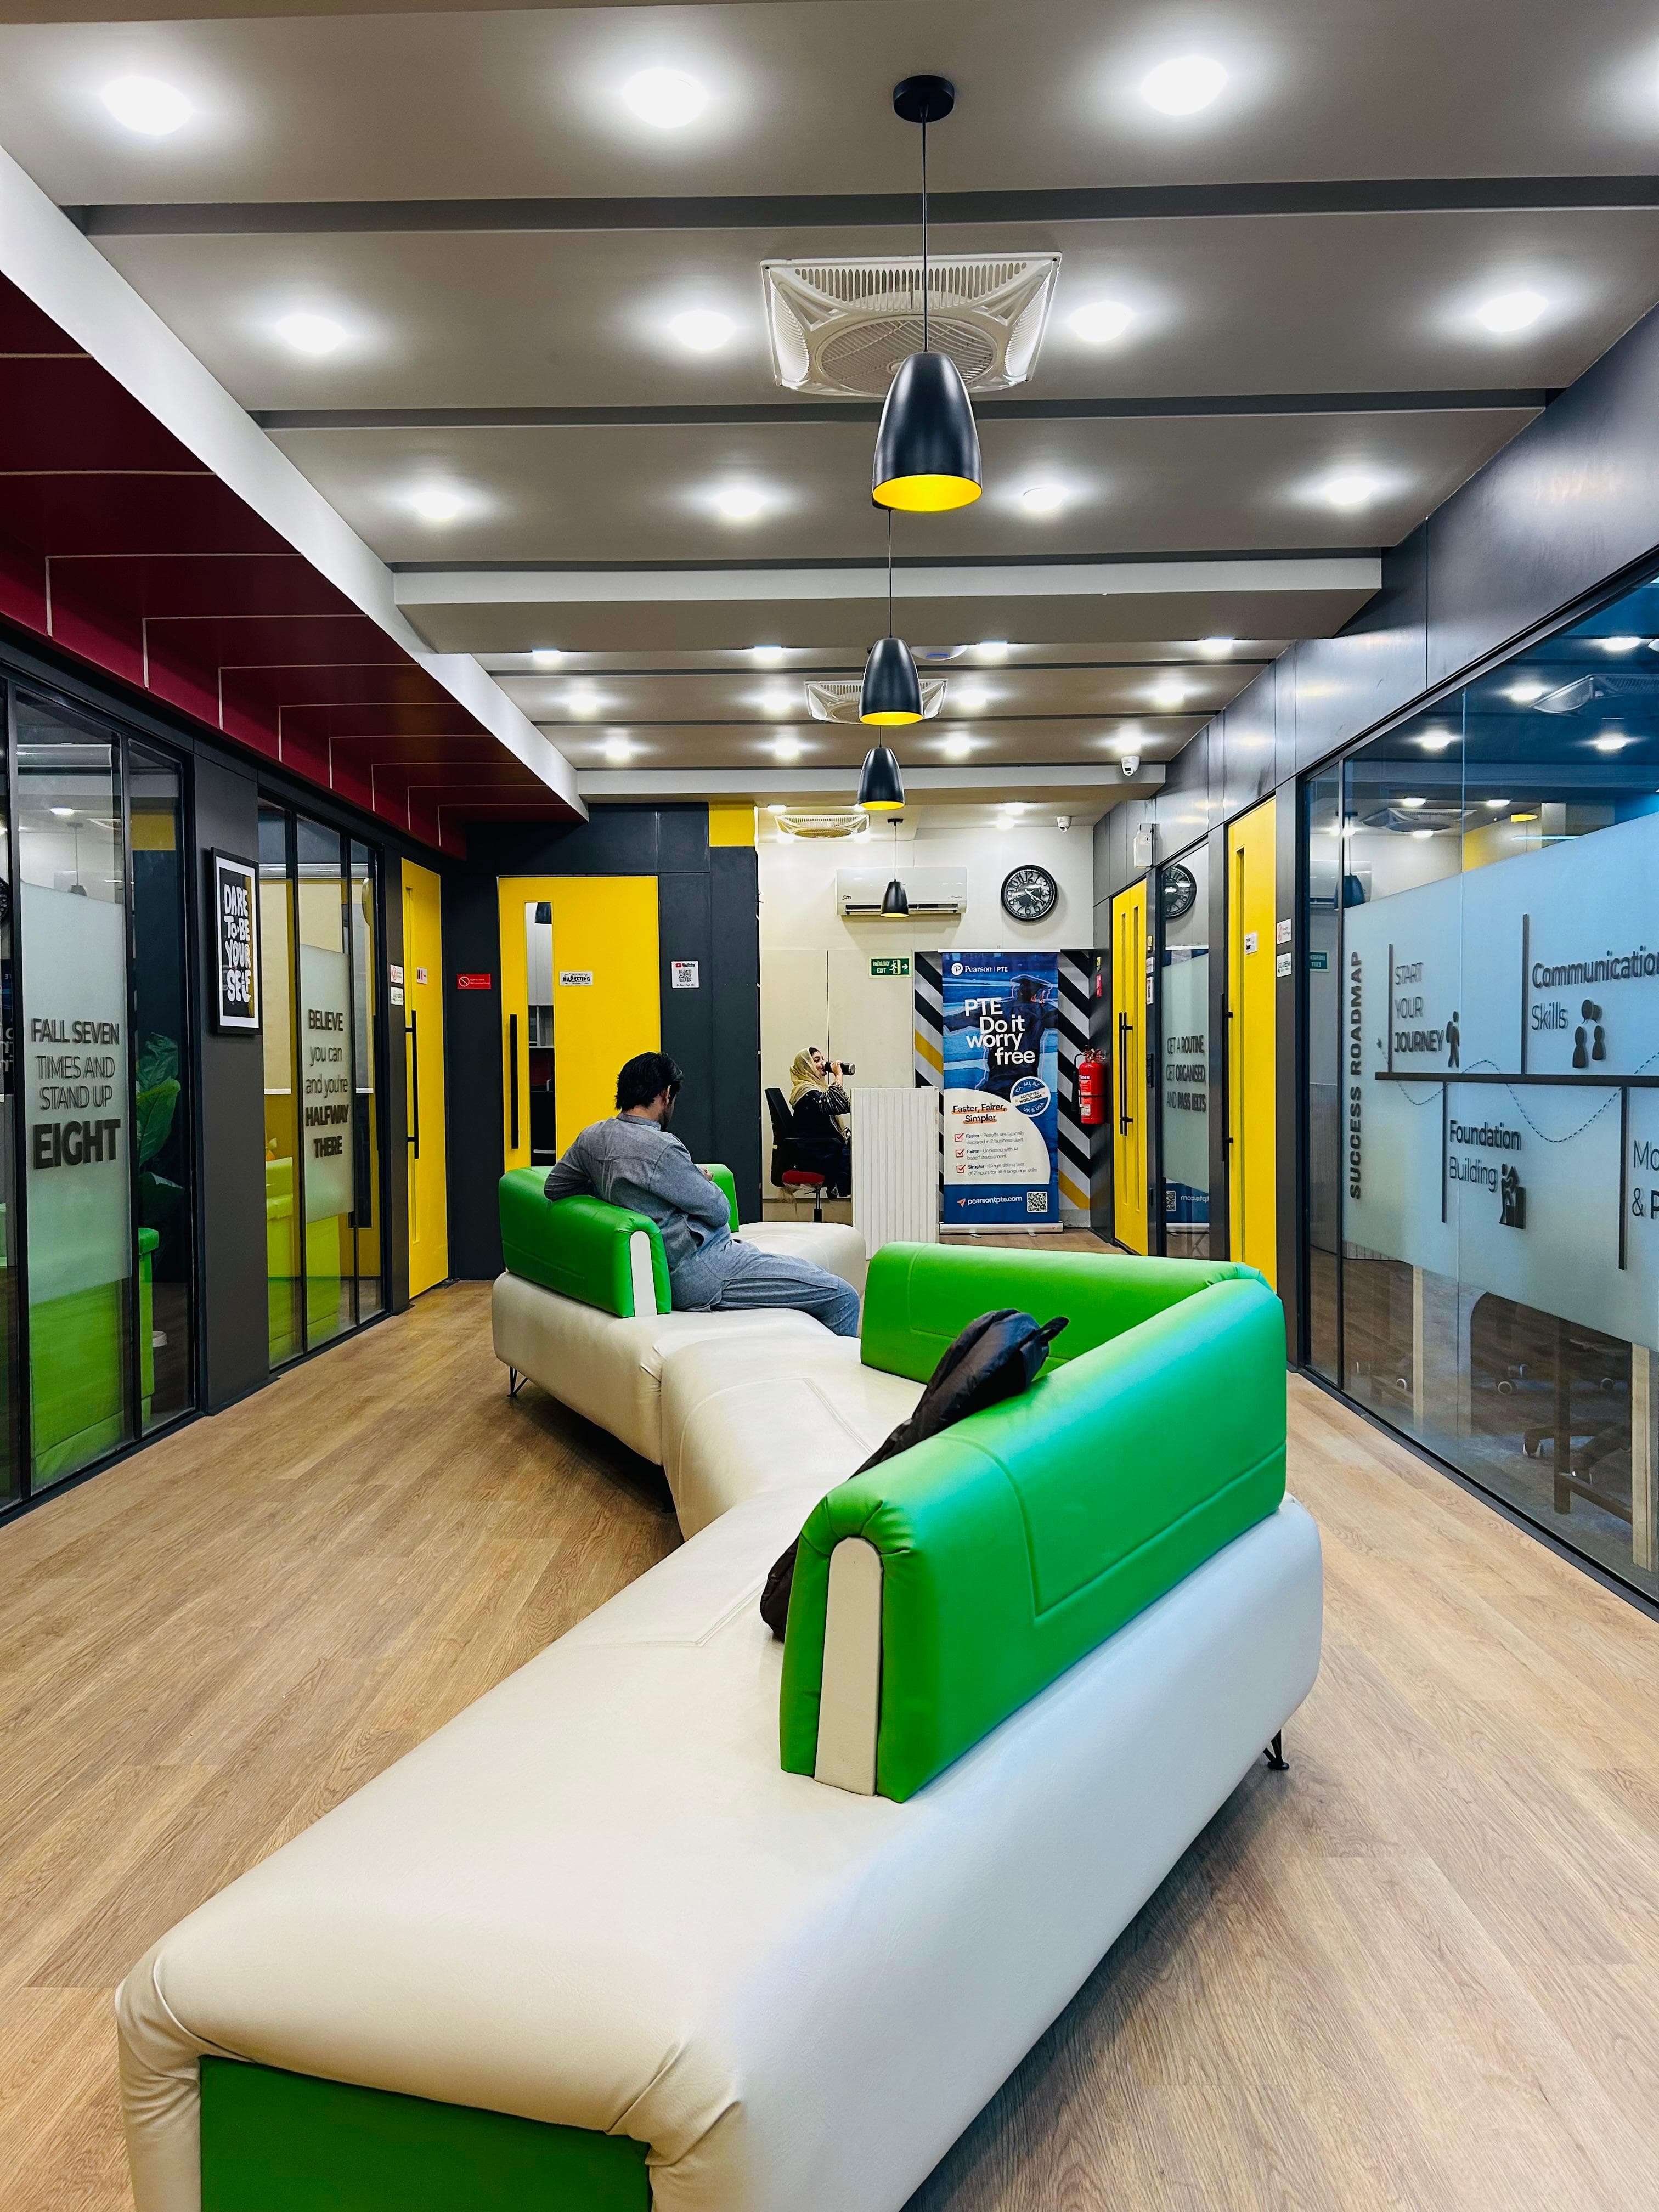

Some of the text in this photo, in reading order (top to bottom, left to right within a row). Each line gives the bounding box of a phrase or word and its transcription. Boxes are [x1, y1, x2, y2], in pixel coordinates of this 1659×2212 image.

[1025, 871, 1033, 881] 12
[224, 884, 248, 917] DARE
[238, 918, 251, 941] BE
[225, 939, 251, 968] YOUR
[1395, 962, 1424, 985] START
[1532, 945, 1659, 988] Communicatio
[964, 997, 1003, 1017] PTE
[1394, 996, 1424, 1019] YOUR
[1531, 1001, 1568, 1030] Skills
[308, 1009, 343, 1031] BELIEVE
[979, 1014, 1025, 1034] Do it
[31, 1018, 70, 1043] FALL
[72, 1020, 120, 1045] SEVEN
[966, 1032, 1023, 1050] worry
[1394, 1029, 1445, 1053] JOURNEY
[309, 1046, 343, 1066] you can
[994, 1047, 1036, 1065] free
[1167, 1035, 1205, 1056] GET A ROUTINE,
[35, 1056, 81, 1079] TIMES
[83, 1056, 115, 1079] AND
[1166, 1064, 1206, 1085] GET ORGANISED,
[1350, 951, 1362, 1200] SUCCESS ROADMAP
[306, 1073, 323, 1094] and
[40, 1085, 113, 1110] STAND UP
[953, 1103, 1006, 1113] Faster, Fairer,
[1019, 1094, 1042, 1103] WORLDWIDE
[1035, 1102, 1045, 1111] USA
[1166, 1091, 1206, 1113] AND PASS IELTS
[305, 1104, 349, 1126] HALFWAY
[964, 1114, 996, 1123] Simpler
[33, 1119, 121, 1170] EIGHT
[1449, 1120, 1521, 1150] Foundation
[313, 1136, 343, 1158] THERE
[1449, 1156, 1498, 1193] Building
[968, 1196, 1023, 1206] pearsontpte.com
[1632, 1187, 1644, 1217] &
